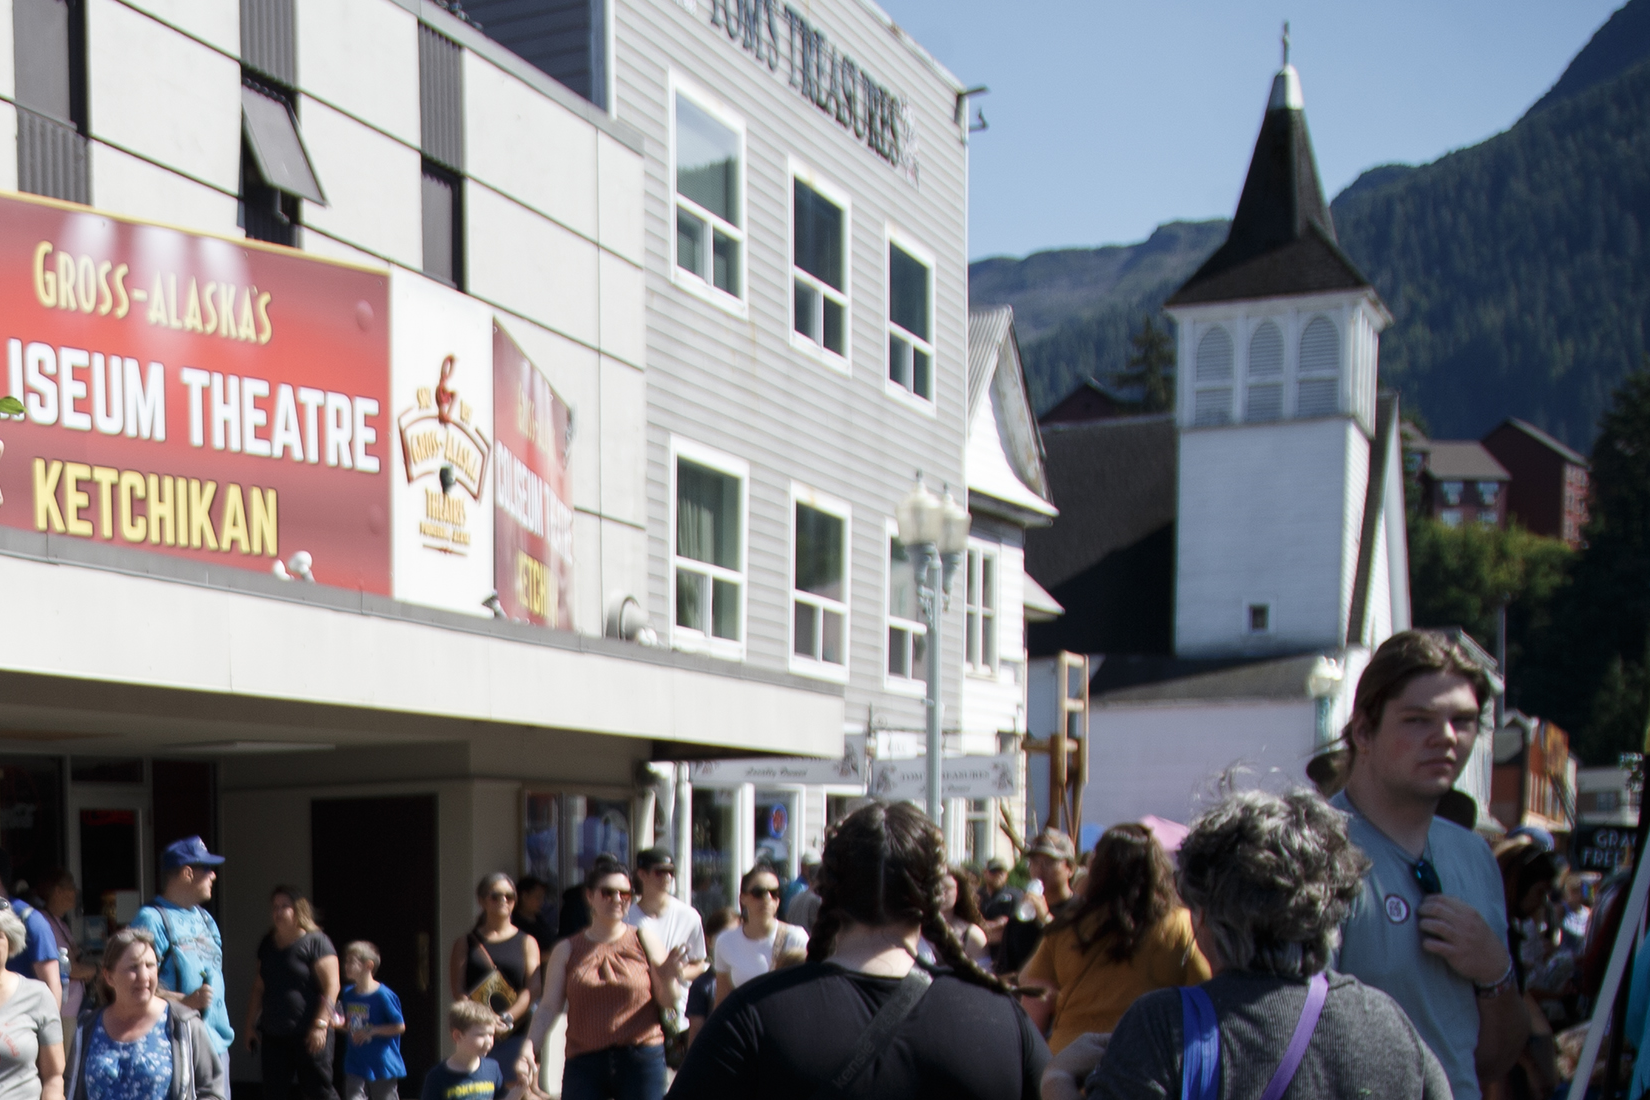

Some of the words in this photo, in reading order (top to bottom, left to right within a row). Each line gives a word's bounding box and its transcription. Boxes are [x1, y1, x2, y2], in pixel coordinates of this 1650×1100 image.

[784, 4, 900, 167] TREASURES
[181, 366, 382, 474] THEATRE
[33, 457, 279, 558] KETCHIKAN
